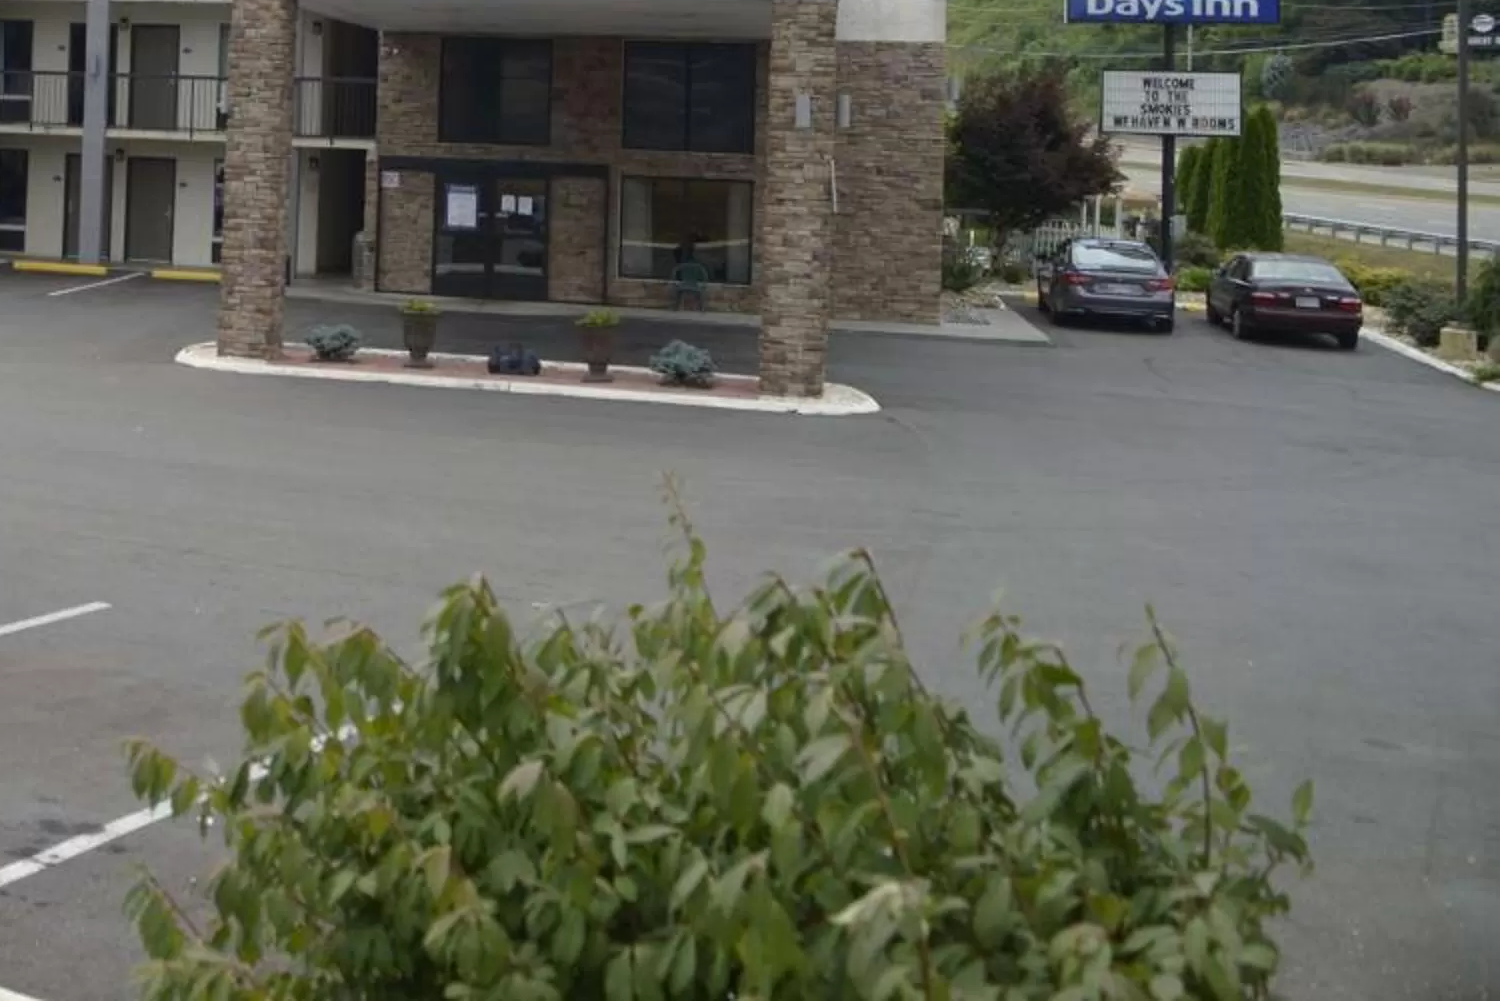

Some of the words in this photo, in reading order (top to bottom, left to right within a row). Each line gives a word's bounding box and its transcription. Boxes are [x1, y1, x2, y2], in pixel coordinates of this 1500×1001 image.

[1142, 78, 1195, 90] WELCOME
[1145, 90, 1159, 102] TO
[1167, 90, 1189, 102] THE
[1140, 103, 1191, 115] SMOKIES
[1191, 117, 1236, 131] ROOMS
